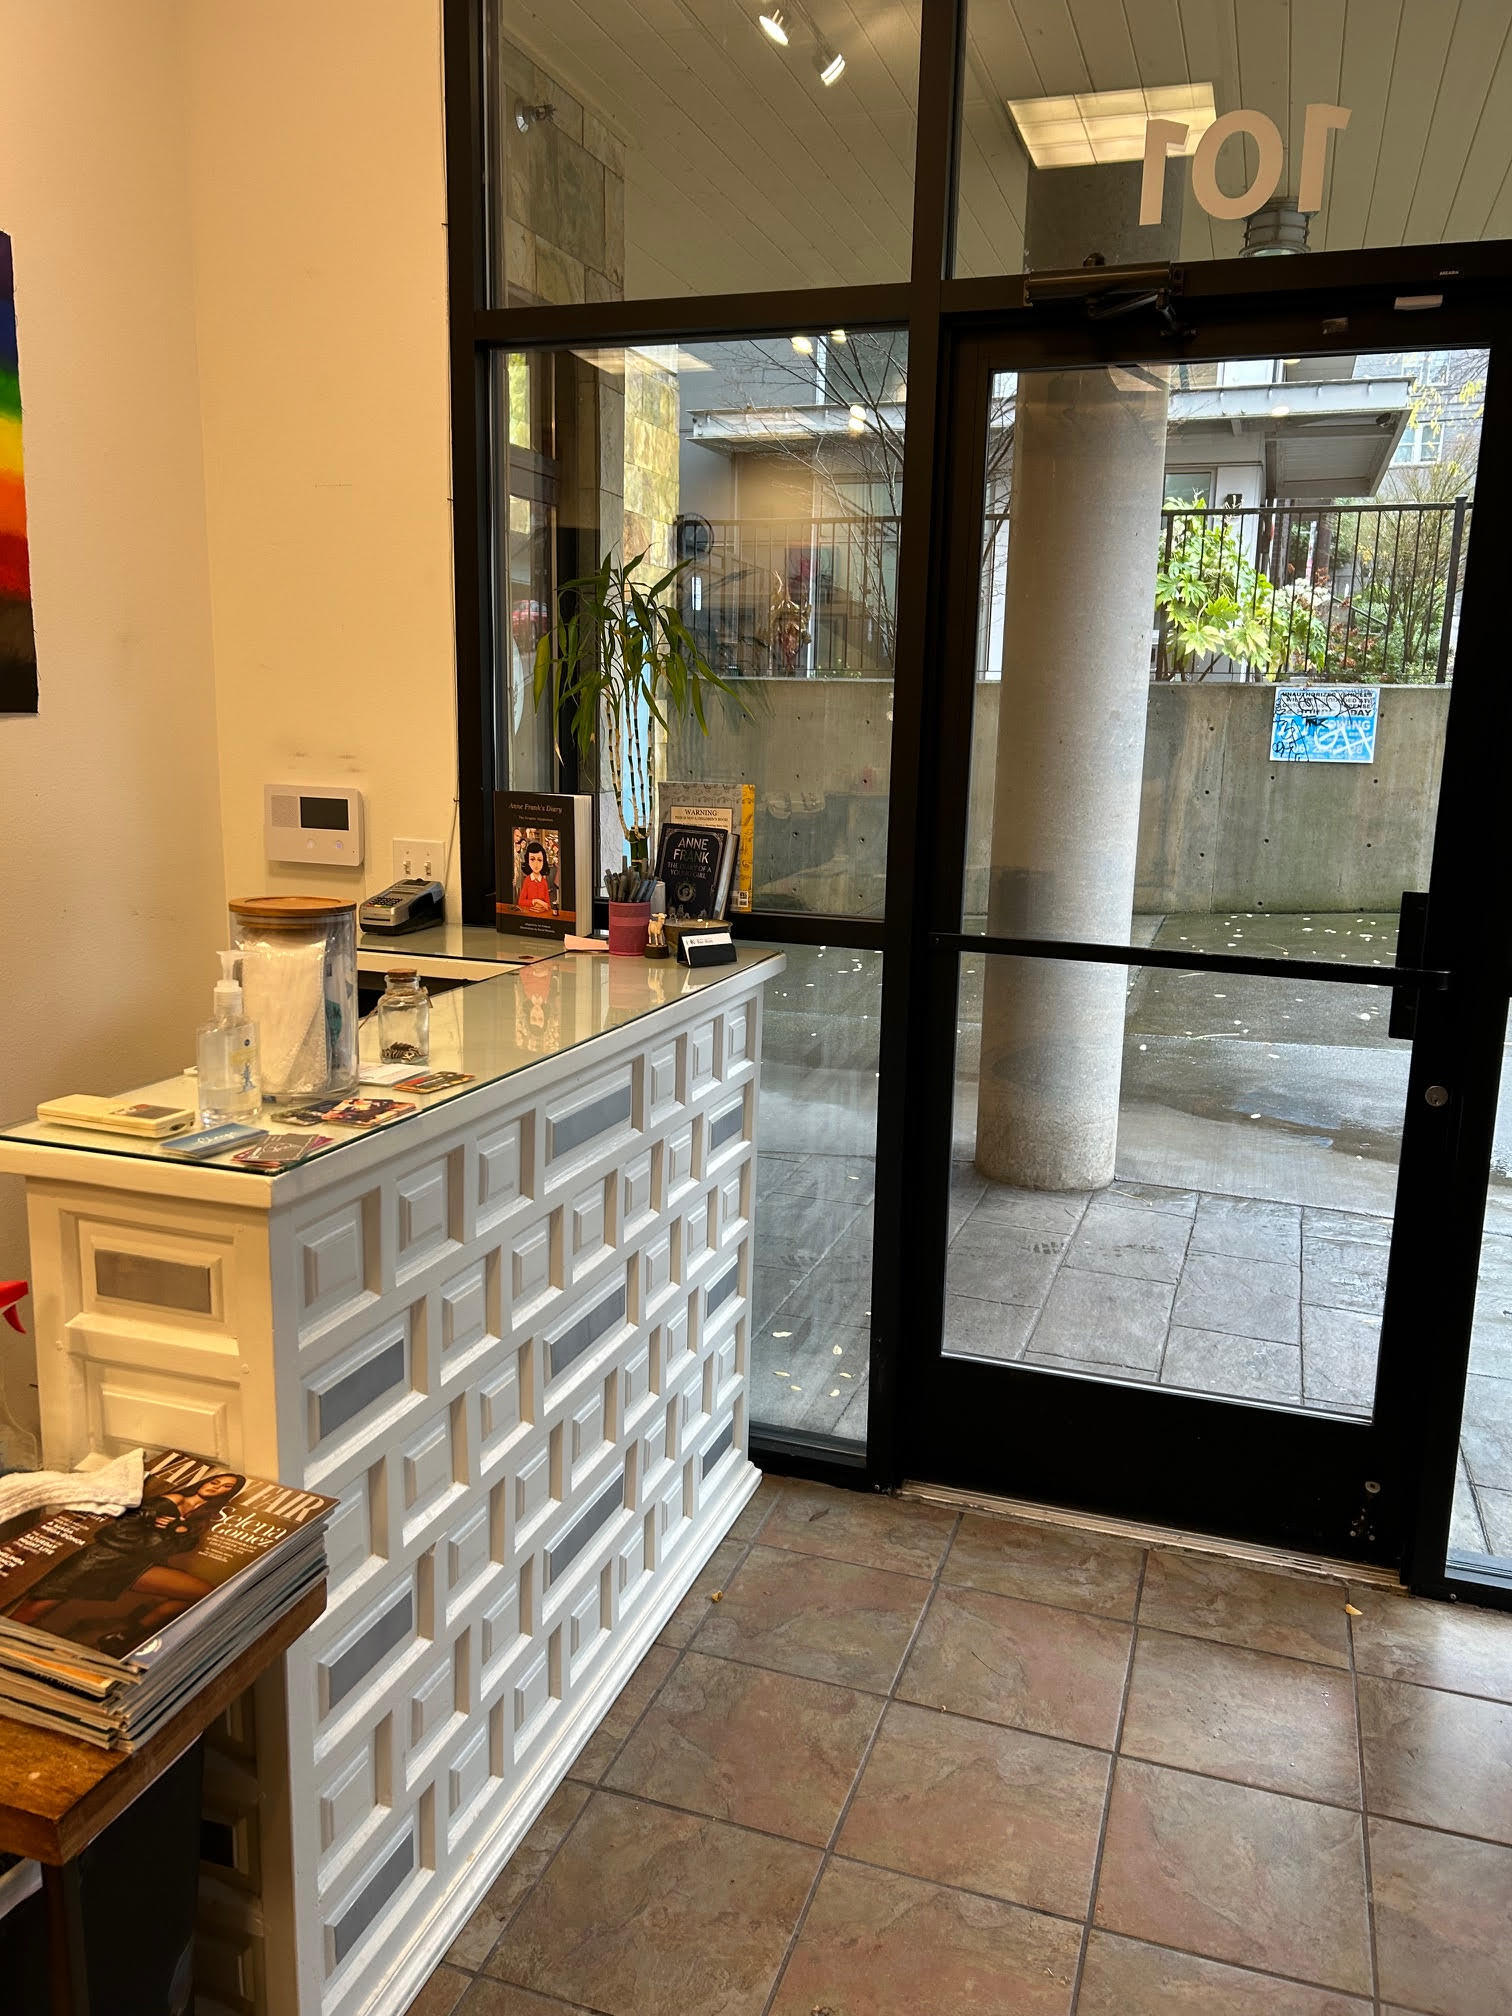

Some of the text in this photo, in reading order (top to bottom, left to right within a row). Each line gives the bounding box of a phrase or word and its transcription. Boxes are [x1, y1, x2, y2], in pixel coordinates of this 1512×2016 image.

[684, 808, 718, 816] WARNING
[678, 837, 709, 851] ANNE
[673, 848, 710, 864] FRANK
[239, 1483, 325, 1522] FAIR
[211, 1506, 287, 1540] Selena
[211, 1523, 274, 1548] Gomez
